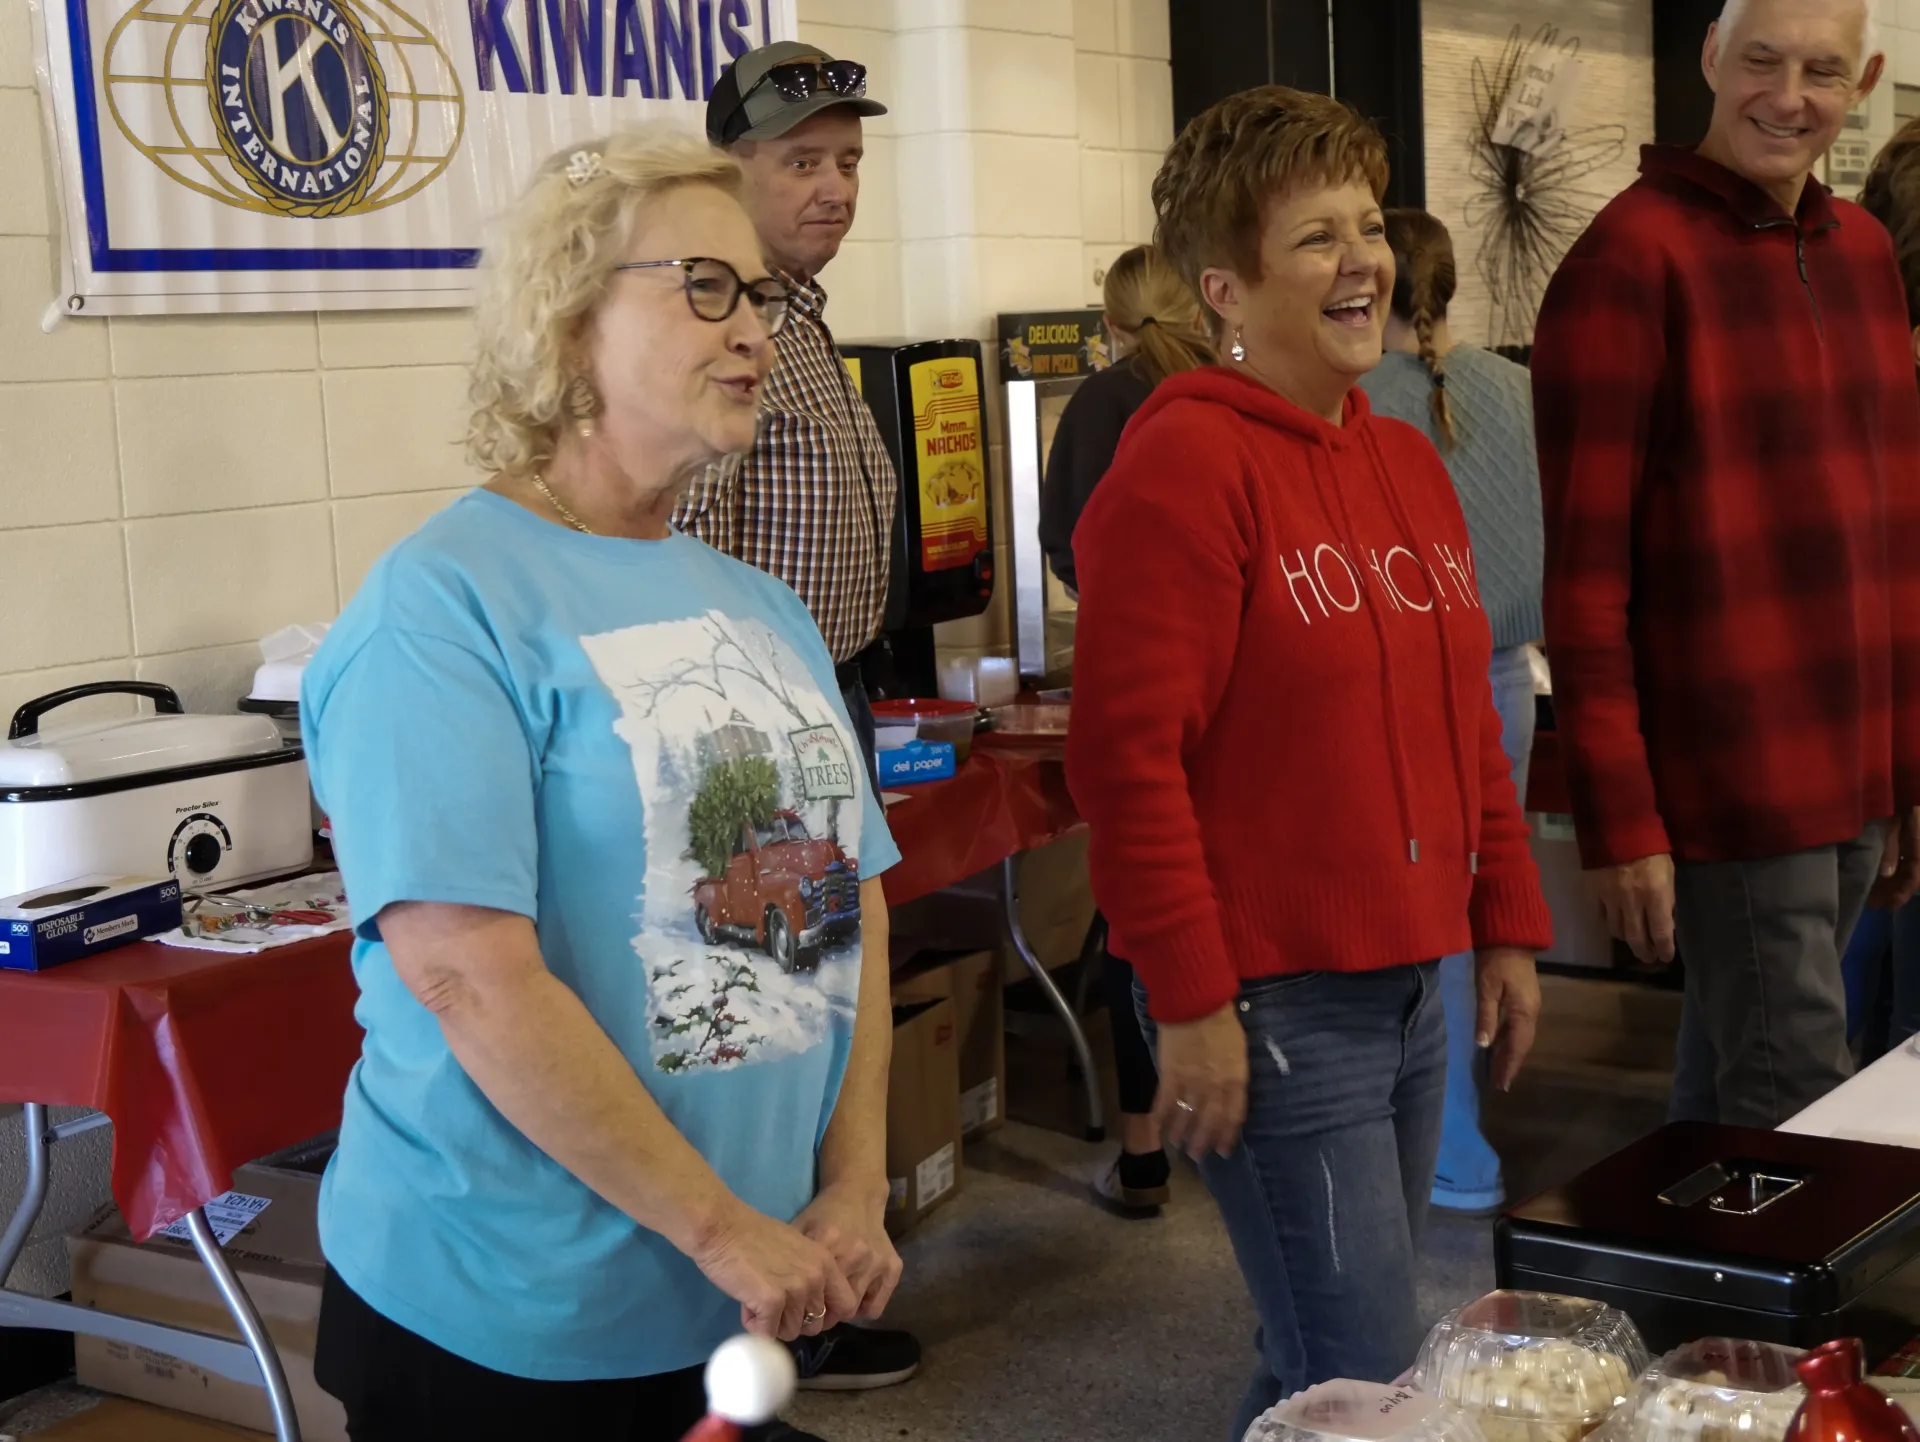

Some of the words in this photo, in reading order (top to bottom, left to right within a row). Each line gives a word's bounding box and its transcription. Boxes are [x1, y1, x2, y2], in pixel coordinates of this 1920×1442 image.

[235, 0, 349, 45] KIWANIS
[468, 0, 757, 101] KIWANIS
[222, 64, 373, 193] INTERNATIONAL
[1028, 323, 1080, 345] DELICIOUS
[926, 432, 977, 457] NACHOS
[804, 763, 849, 787] TREES
[892, 760, 911, 773] deli
[913, 757, 944, 773] paper
[175, 804, 202, 814] Proctor
[201, 800, 219, 809] Silex
[161, 886, 177, 899] 500
[12, 923, 29, 933] 500
[36, 911, 85, 934] DISPOSABLE
[46, 922, 79, 940] GLOVES
[121, 918, 136, 928] Mark
[223, 1194, 269, 1210] HA142A
